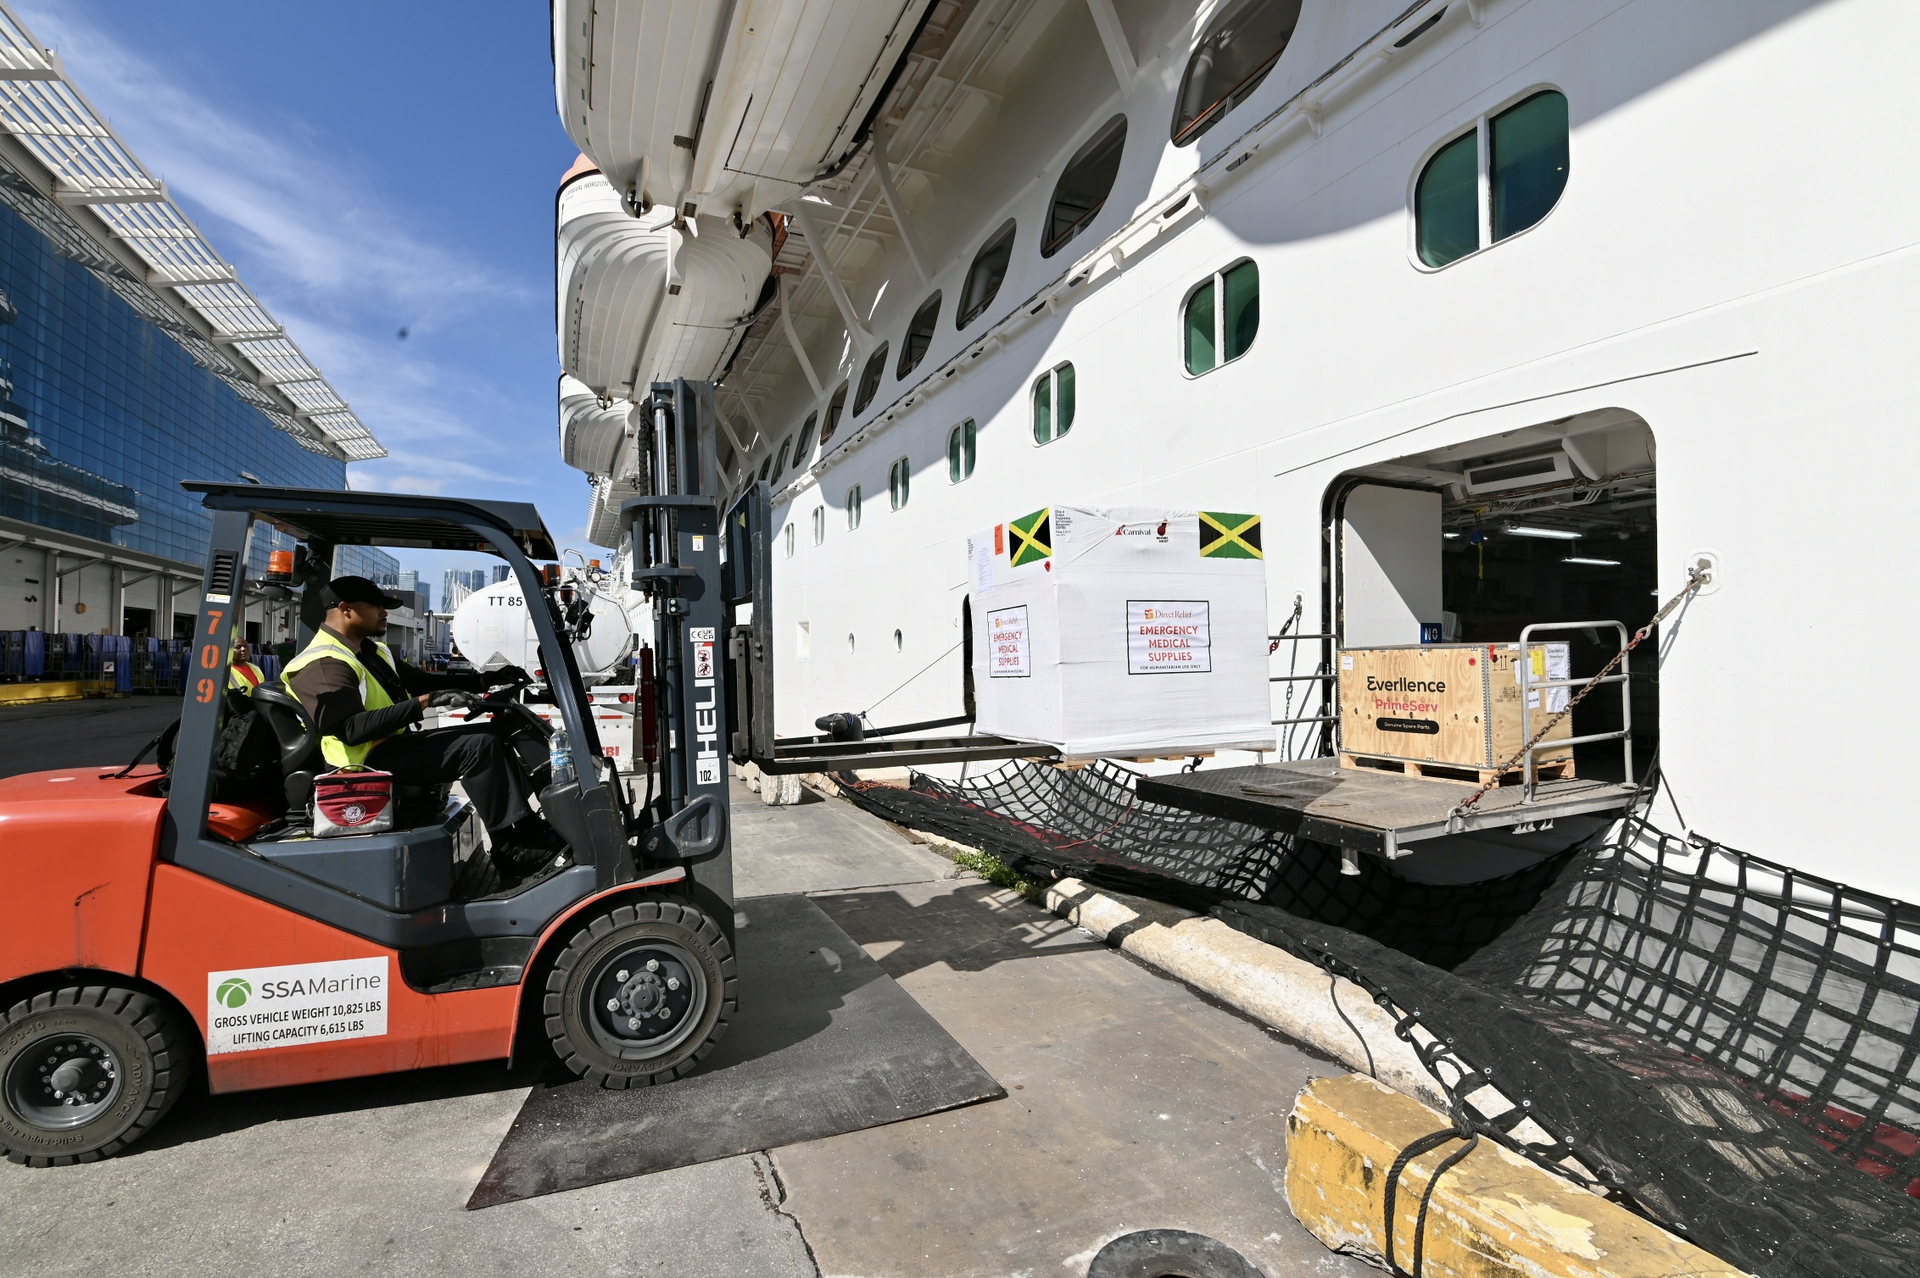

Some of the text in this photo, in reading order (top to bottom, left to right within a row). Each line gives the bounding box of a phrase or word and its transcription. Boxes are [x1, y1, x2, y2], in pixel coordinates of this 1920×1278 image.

[1123, 528, 1152, 536] Carnival
[488, 596, 523, 606] TT 85
[1140, 625, 1198, 635] EMERGENCY
[1424, 627, 1438, 640] NO
[993, 631, 1023, 642] EMERGENCY
[998, 644, 1019, 654] MEDICAL
[1148, 639, 1191, 649] MEDICAL
[998, 657, 1020, 667] SUPPLIES
[1148, 652, 1193, 662] SUPPLIES
[1367, 676, 1446, 693] Everllence
[1375, 698, 1438, 713] PrimeServ
[694, 679, 718, 758] HELI
[699, 770, 712, 782] 102
[214, 1000, 382, 1029] GROSS VEHICLE WEIGHT 10,825 LBS
[233, 1020, 364, 1045] LIFTING CAPACITY 6,615 LBS
[115, 1062, 143, 1120] ADVANCE
